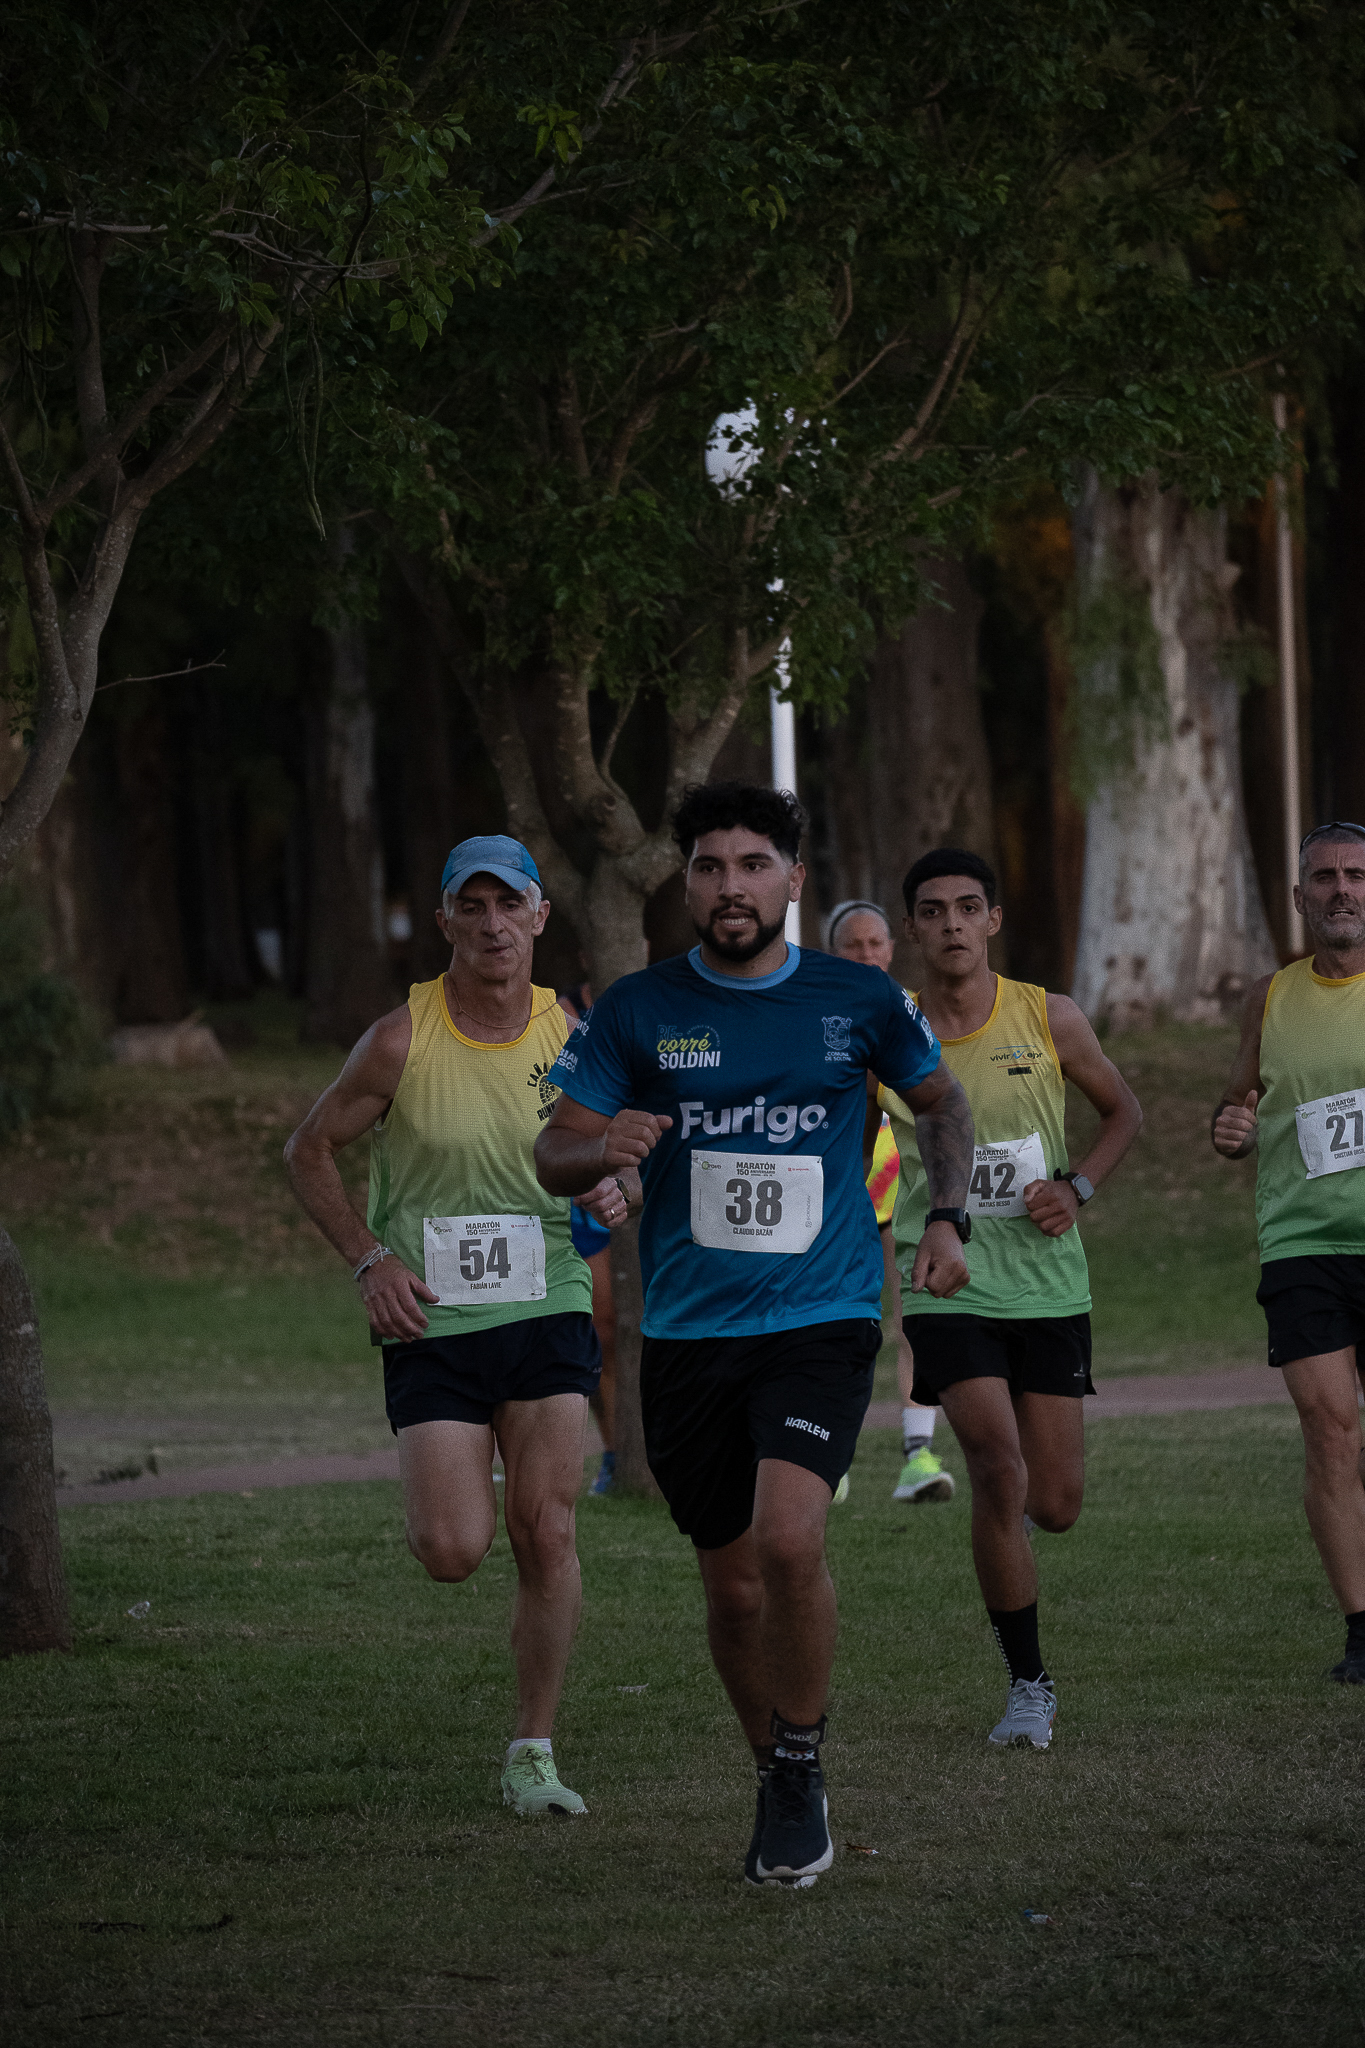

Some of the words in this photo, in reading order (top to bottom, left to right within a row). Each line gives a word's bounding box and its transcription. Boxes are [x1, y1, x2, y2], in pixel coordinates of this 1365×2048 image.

[657, 1032, 712, 1055] corré
[659, 1051, 721, 1070] SOLDINI
[679, 1095, 827, 1144] Furigo
[1325, 1109, 1364, 1153] 27
[975, 1148, 1009, 1157] MARATÓN
[736, 1161, 776, 1170] MARATÓN
[970, 1162, 1017, 1200] 42
[725, 1178, 783, 1227] 38
[465, 1221, 501, 1230] MARATÓN
[733, 1227, 755, 1235] CLAUDIO
[459, 1237, 512, 1282] 54
[488, 1281, 502, 1289] LAVIE
[784, 1416, 831, 1442] HARLEM
[774, 1748, 816, 1761] SOX
